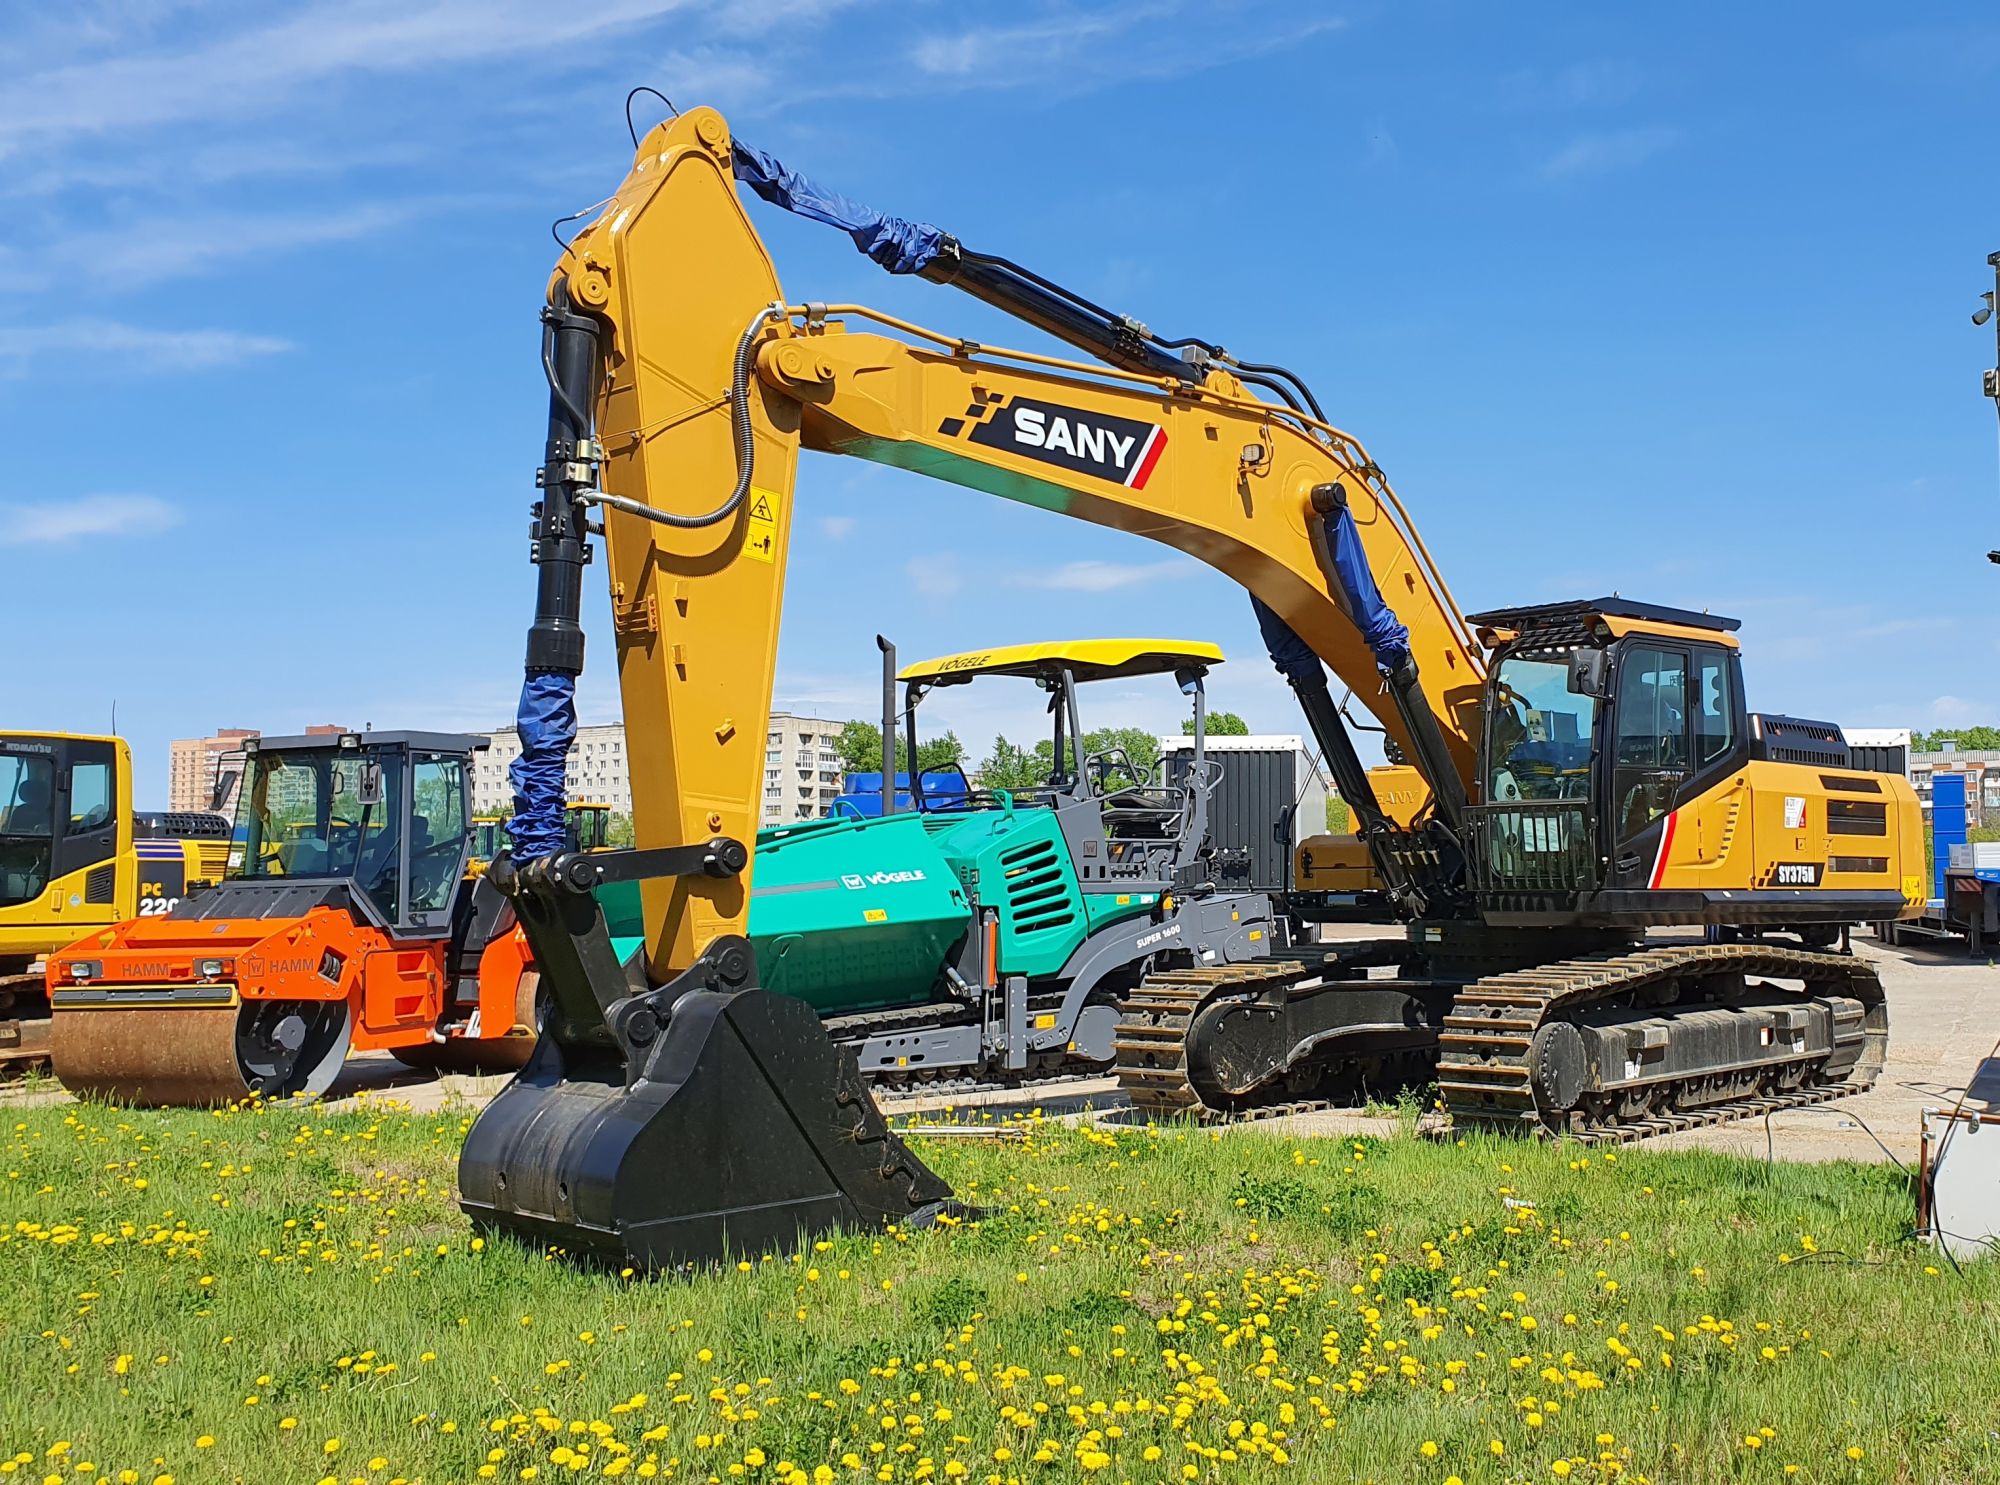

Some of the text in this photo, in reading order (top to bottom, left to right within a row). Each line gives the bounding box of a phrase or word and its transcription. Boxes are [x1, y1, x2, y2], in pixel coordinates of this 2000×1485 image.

[1014, 407, 1136, 469] SANY
[6, 742, 52, 753] KOMATSU
[865, 870, 927, 885] VÖGELE
[1778, 865, 1815, 883] SY375H
[141, 882, 162, 897] PC
[1136, 924, 1181, 949] SUPER 1600
[121, 962, 170, 977] HAMM
[269, 957, 315, 974] HAMM
